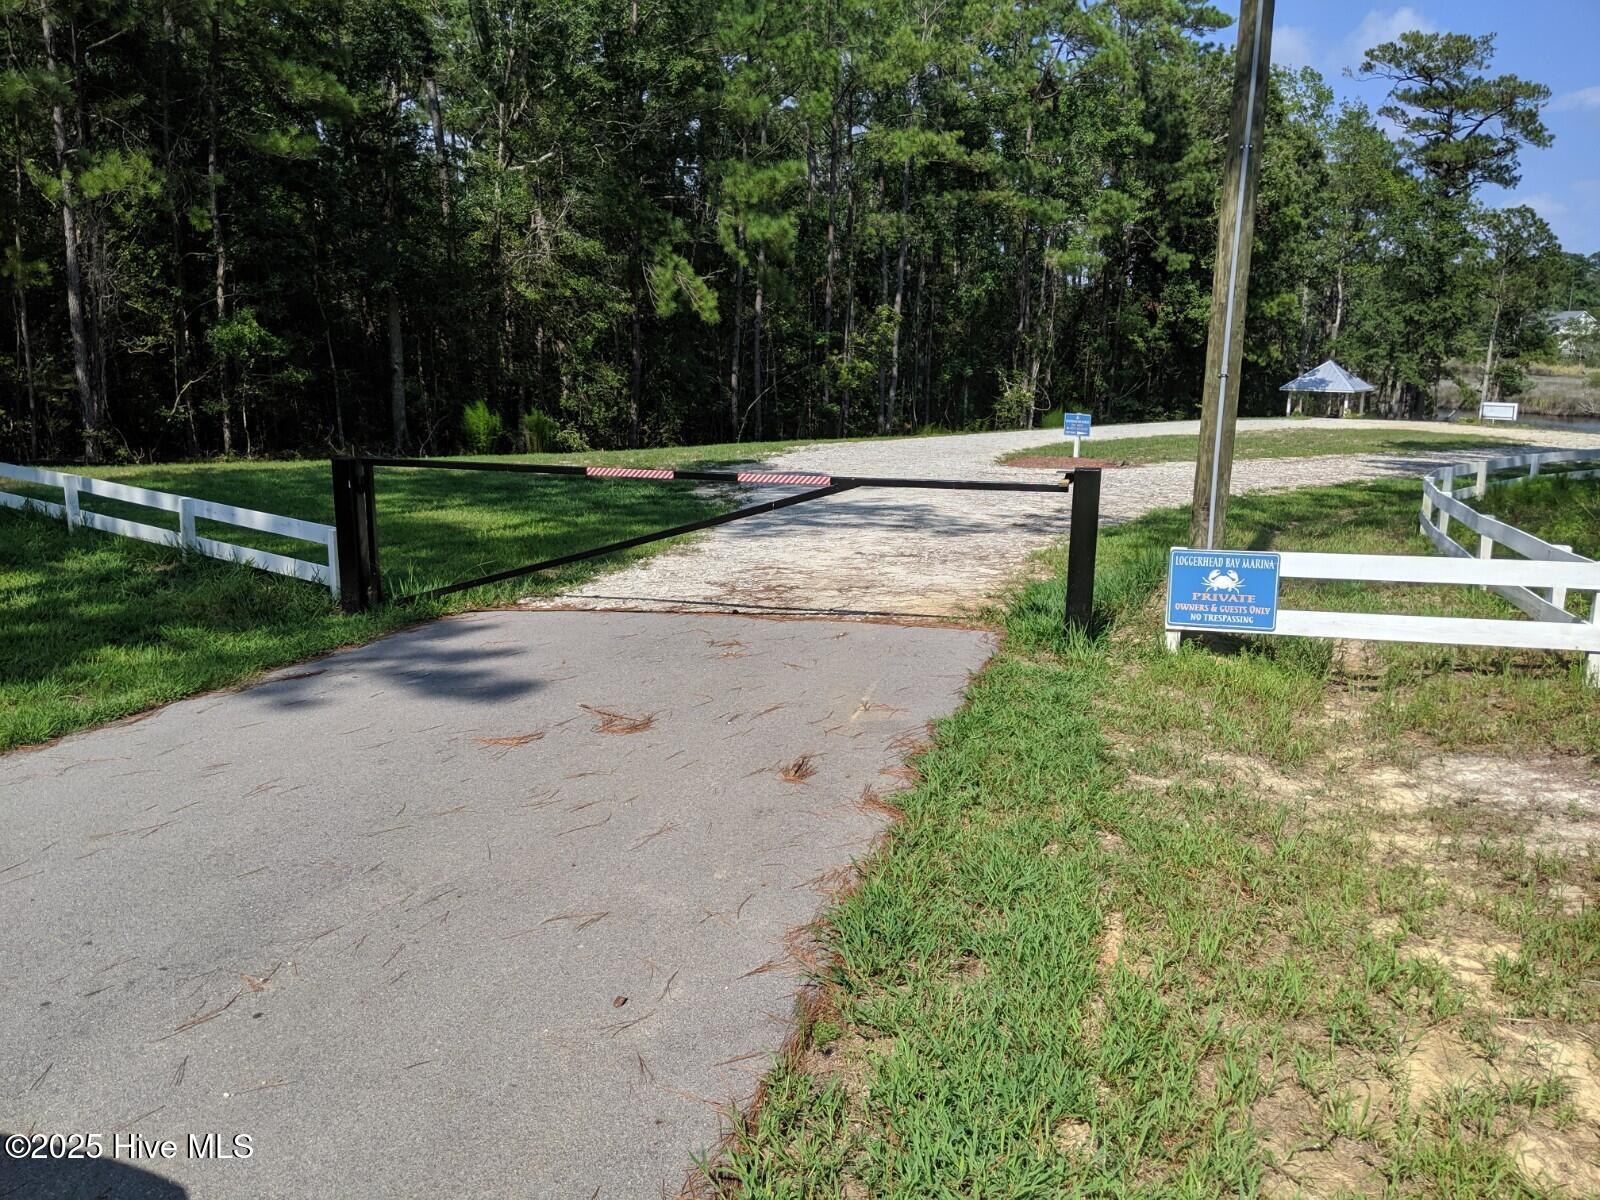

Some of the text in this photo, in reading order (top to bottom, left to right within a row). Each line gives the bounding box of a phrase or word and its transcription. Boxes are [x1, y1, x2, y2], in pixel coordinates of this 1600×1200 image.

[1175, 555, 1275, 569] LOGGERHEAD BAY MARINA
[1192, 592, 1256, 602] PRIVATE
[1175, 603, 1271, 615] OWNERS & GUESTS ONLY
[1190, 613, 1254, 624] NO TRESPASSING
